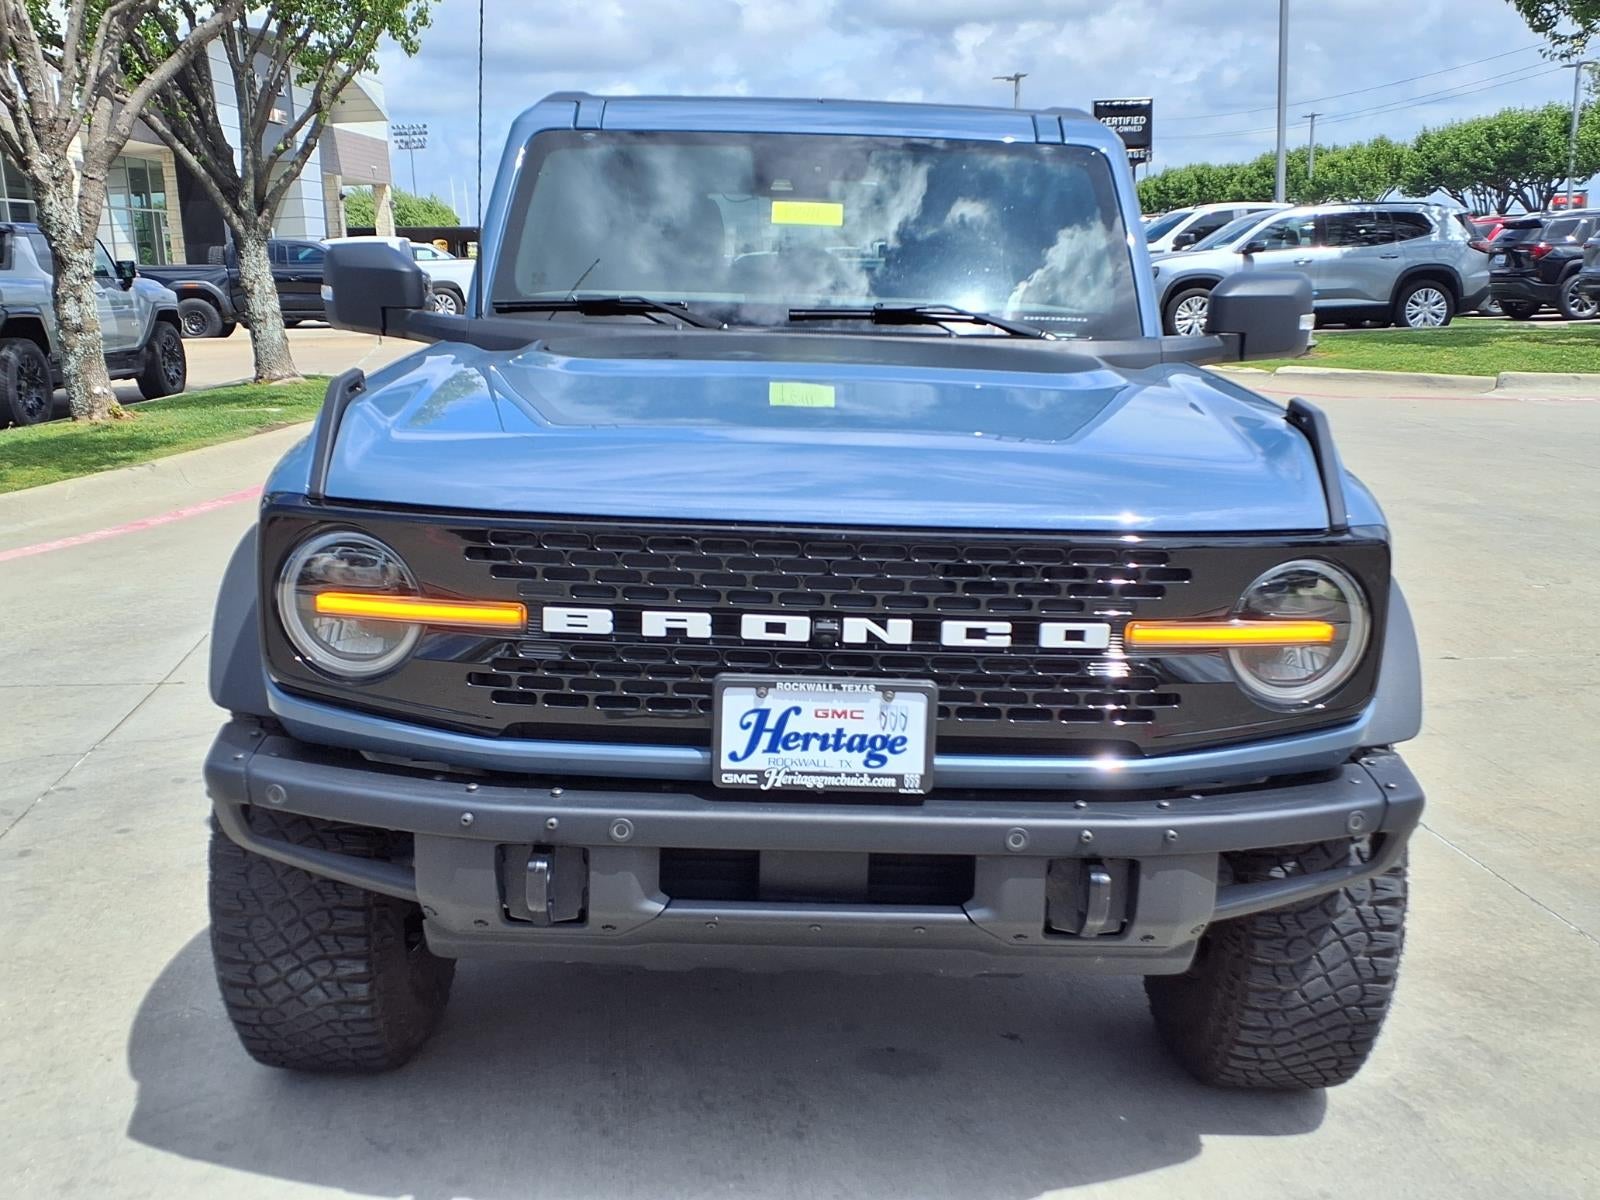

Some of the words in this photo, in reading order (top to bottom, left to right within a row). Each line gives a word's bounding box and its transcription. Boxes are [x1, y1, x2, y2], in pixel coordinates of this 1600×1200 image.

[1100, 116, 1147, 126] CERTIFIED
[542, 606, 1112, 649] BRONCO
[841, 683, 876, 693] TEXAS
[814, 708, 864, 720] GMC
[728, 706, 907, 769] Heritage
[839, 759, 852, 769] TX
[721, 773, 758, 785] GMC
